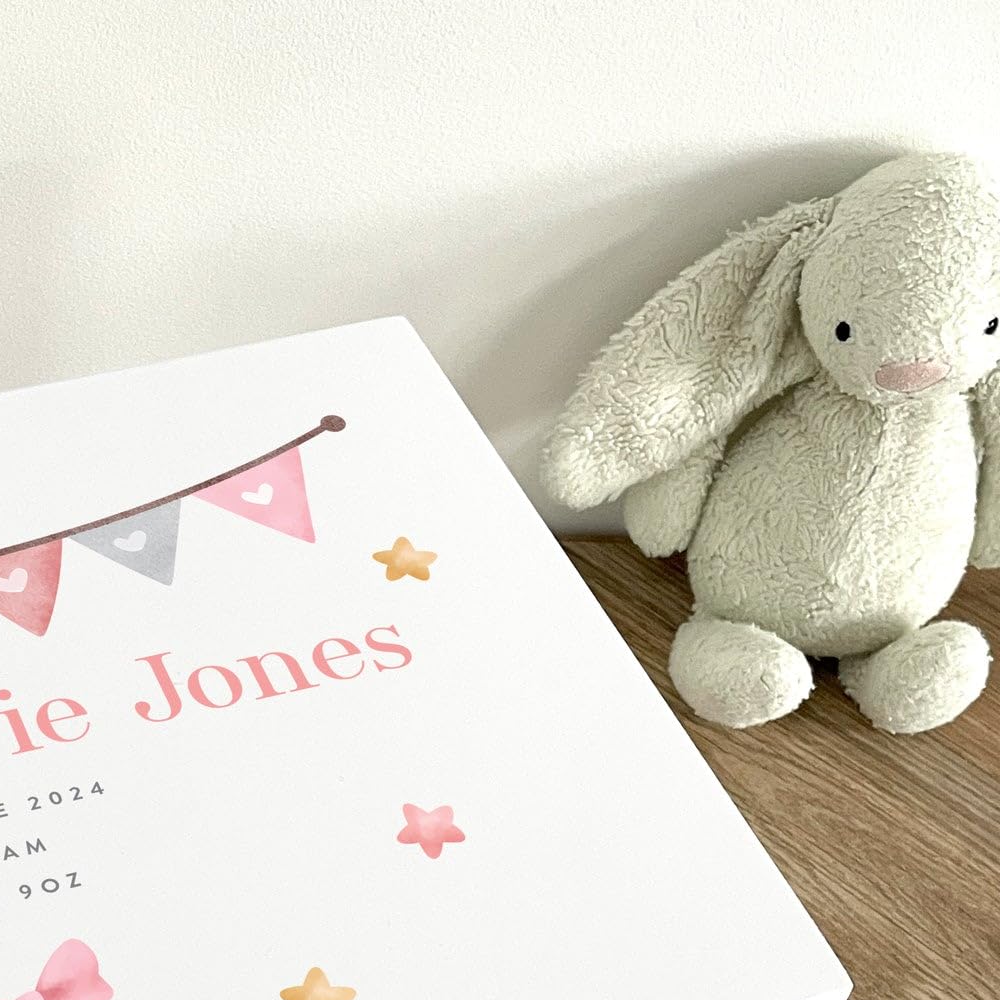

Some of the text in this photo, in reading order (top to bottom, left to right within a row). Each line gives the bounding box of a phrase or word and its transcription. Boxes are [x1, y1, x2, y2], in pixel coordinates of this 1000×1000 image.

[134, 624, 414, 723] Jones
[27, 780, 106, 811] 2024
[18, 871, 83, 900] 9OZ
